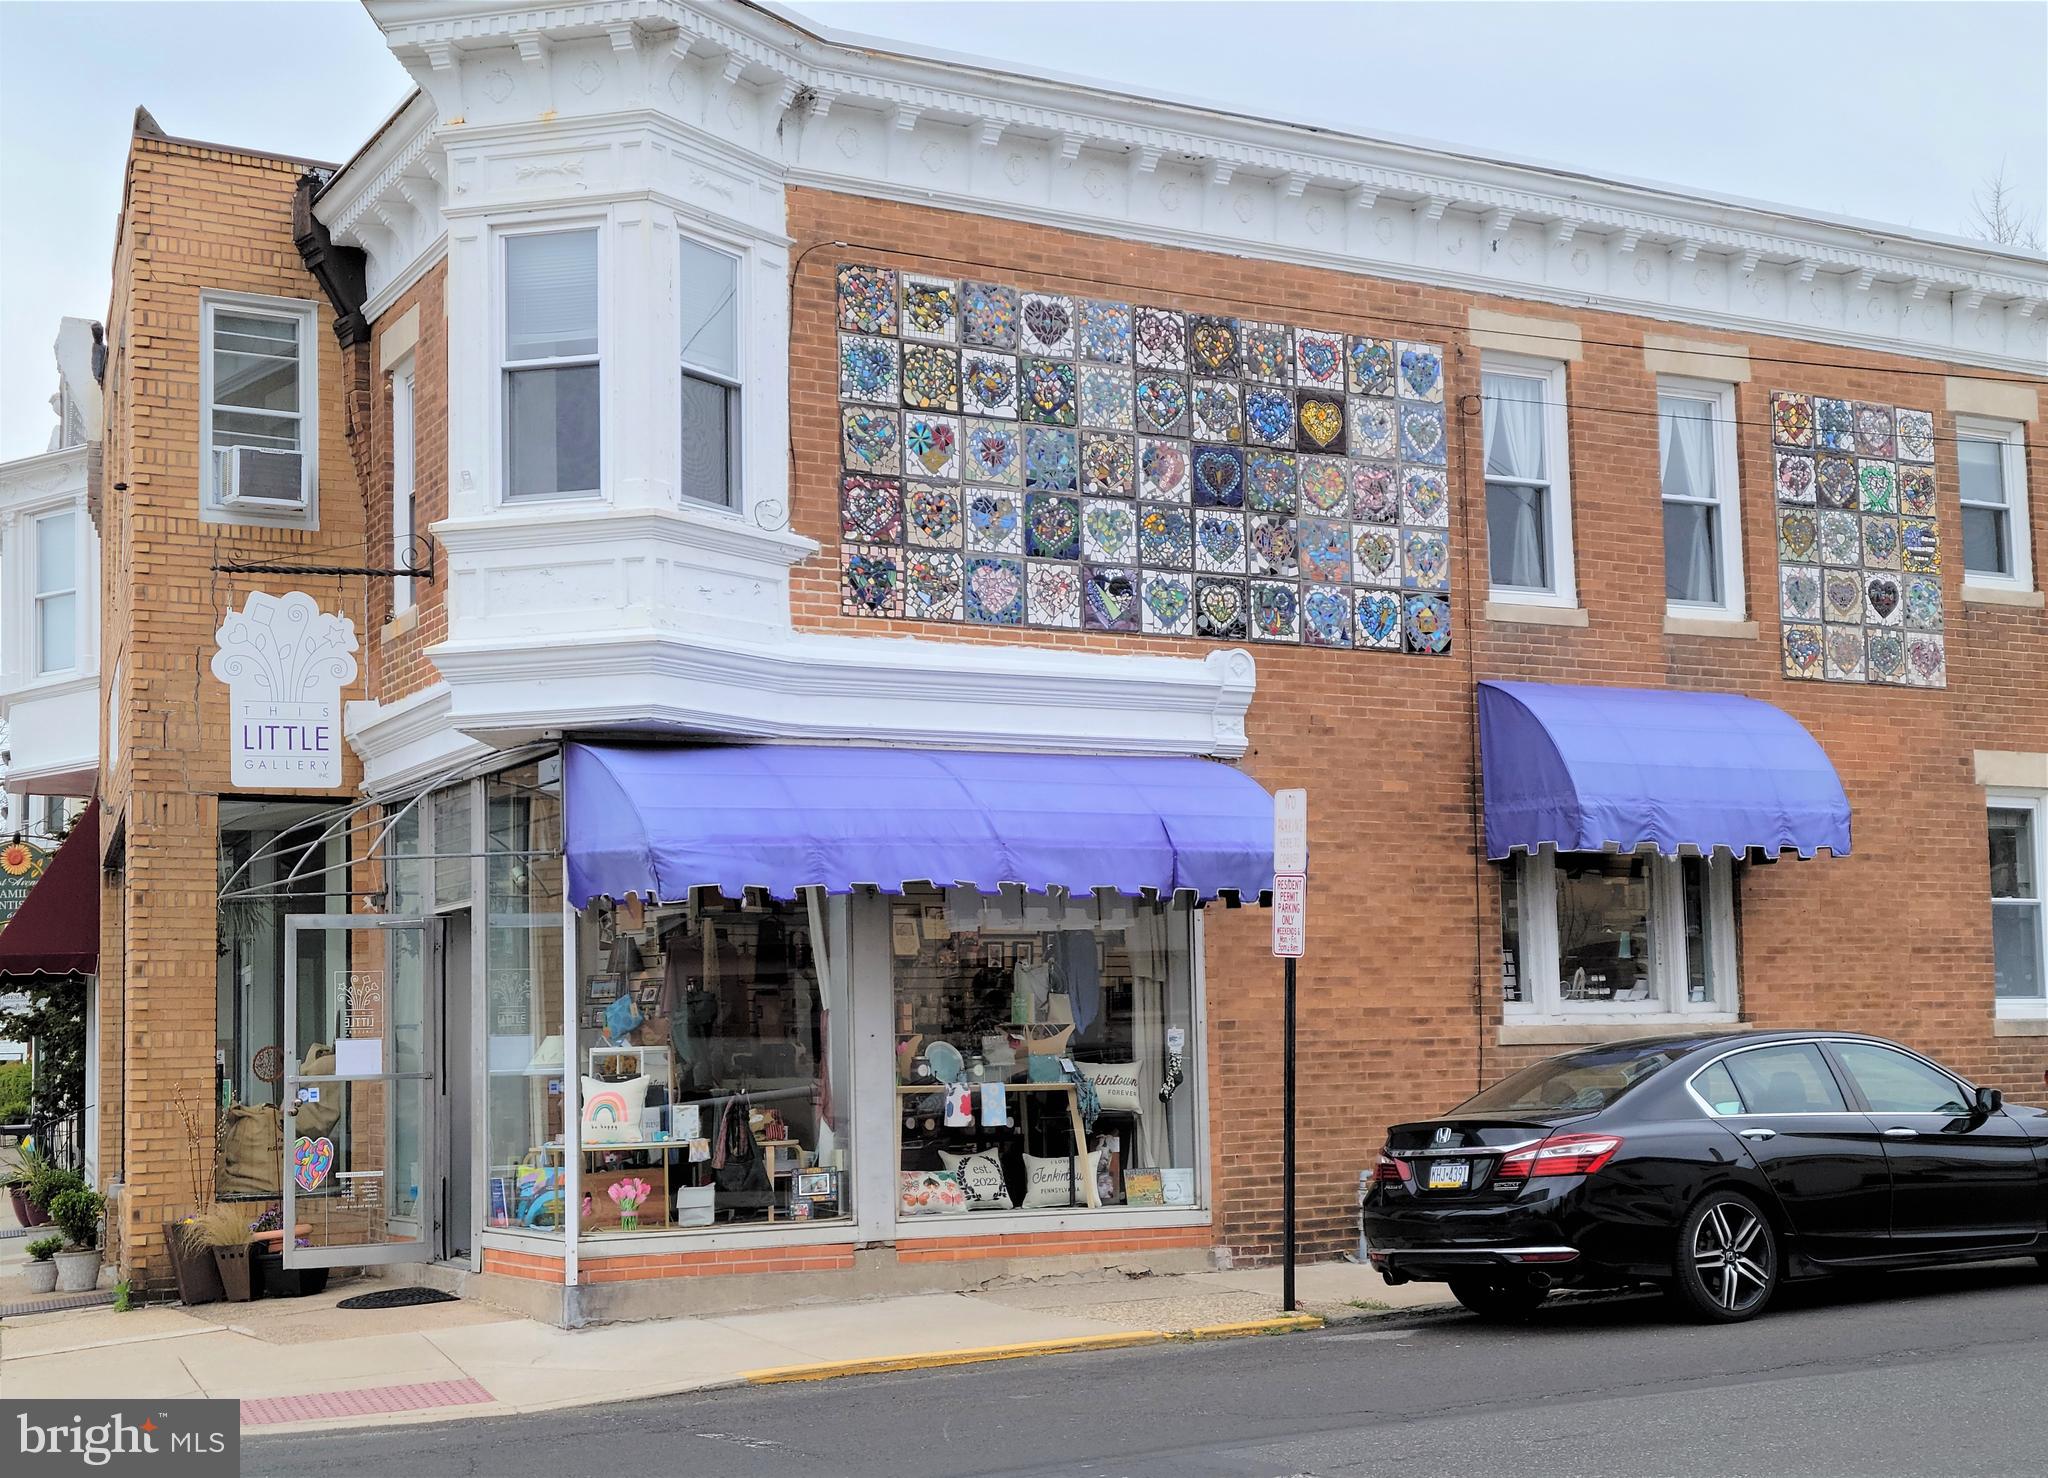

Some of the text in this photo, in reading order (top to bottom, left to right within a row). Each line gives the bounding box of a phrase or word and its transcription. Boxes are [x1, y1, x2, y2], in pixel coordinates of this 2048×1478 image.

[244, 706, 328, 717] THIS
[244, 725, 329, 751] LITTLE
[244, 759, 329, 771] GALLERY
[1277, 879, 1302, 890] RESIDENT
[1280, 891, 1299, 902] PERMIT
[1278, 902, 1300, 914] PARKING
[1281, 915, 1295, 926] ONLY
[973, 1165, 991, 1174] est.
[973, 1177, 998, 1187] 2022
